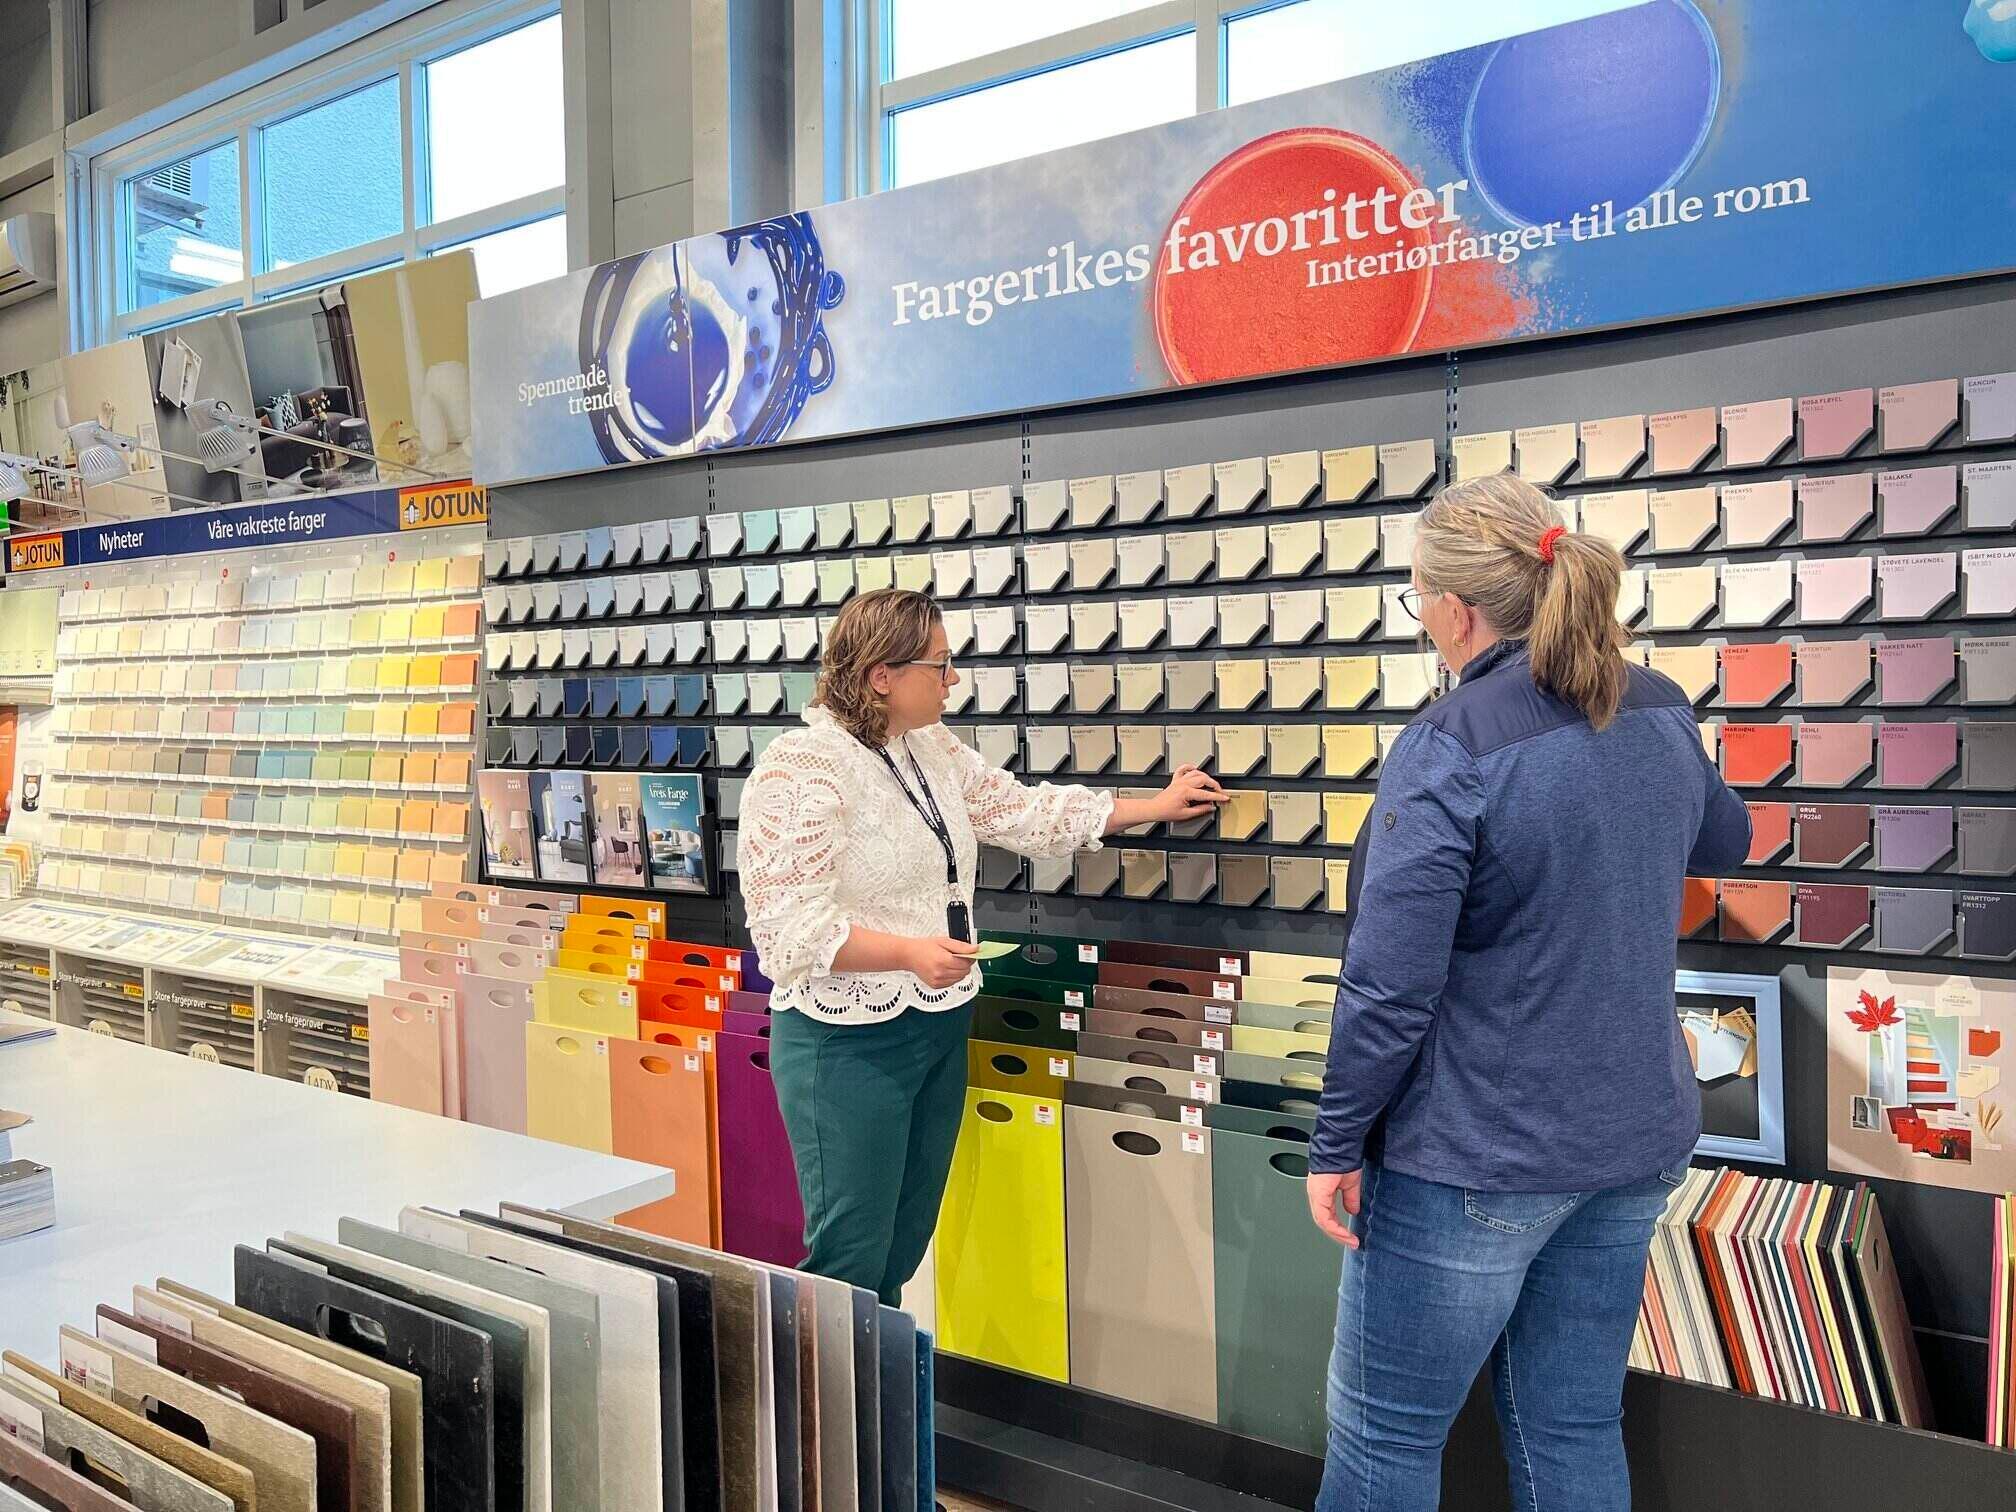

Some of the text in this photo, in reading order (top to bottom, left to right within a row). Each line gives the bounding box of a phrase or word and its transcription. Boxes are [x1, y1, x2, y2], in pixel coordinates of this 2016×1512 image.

[1305, 176, 1811, 287] Interiørfarger til alle rom
[890, 178, 1469, 326] Fargerikes favoritter
[518, 362, 608, 406] Spennende
[568, 386, 630, 416] trender
[423, 489, 485, 518] JOTUN
[207, 511, 327, 539] Våre vakreste farger
[24, 542, 62, 565] JOTUN
[99, 531, 145, 554] Nyheter
[1910, 557, 1945, 565] LAVENDEL
[668, 788, 690, 803] Farge
[1799, 806, 1817, 814] GRUE
[1962, 895, 2002, 903] SVARTTOPP
[58, 971, 73, 982] Store
[154, 991, 208, 1009] Store fargeprover
[266, 1008, 325, 1030] Store fargeprover
